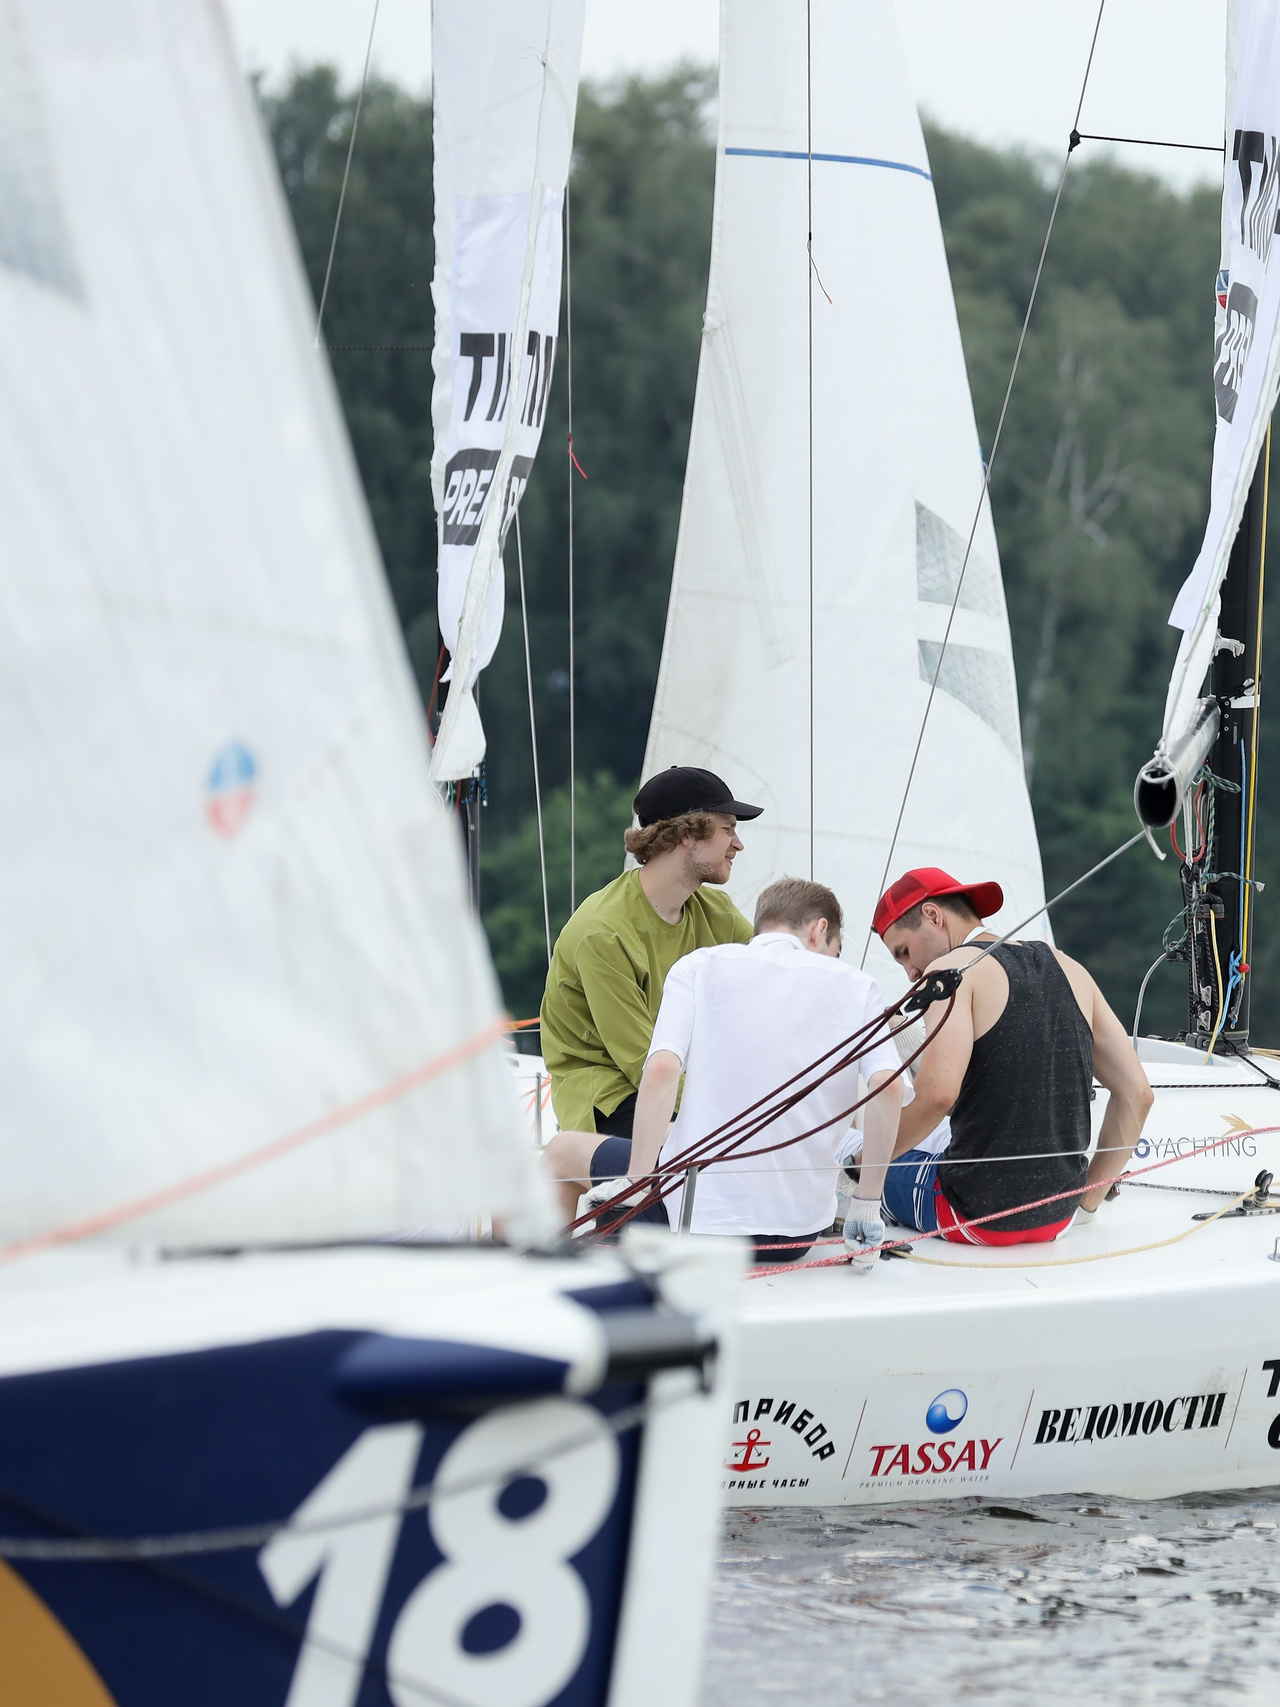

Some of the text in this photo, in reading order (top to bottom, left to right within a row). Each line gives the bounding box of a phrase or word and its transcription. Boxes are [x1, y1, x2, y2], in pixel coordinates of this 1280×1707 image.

[1130, 1135, 1258, 1160] OYACHTING
[1032, 1392, 1228, 1447] ВЕДОМОСТИ
[868, 1437, 1004, 1477] TASSAY
[771, 1478, 810, 1489] ЧАСЫ
[859, 1475, 990, 1489] PREMIUM DRINKING WATER
[258, 1399, 622, 1707] 18
